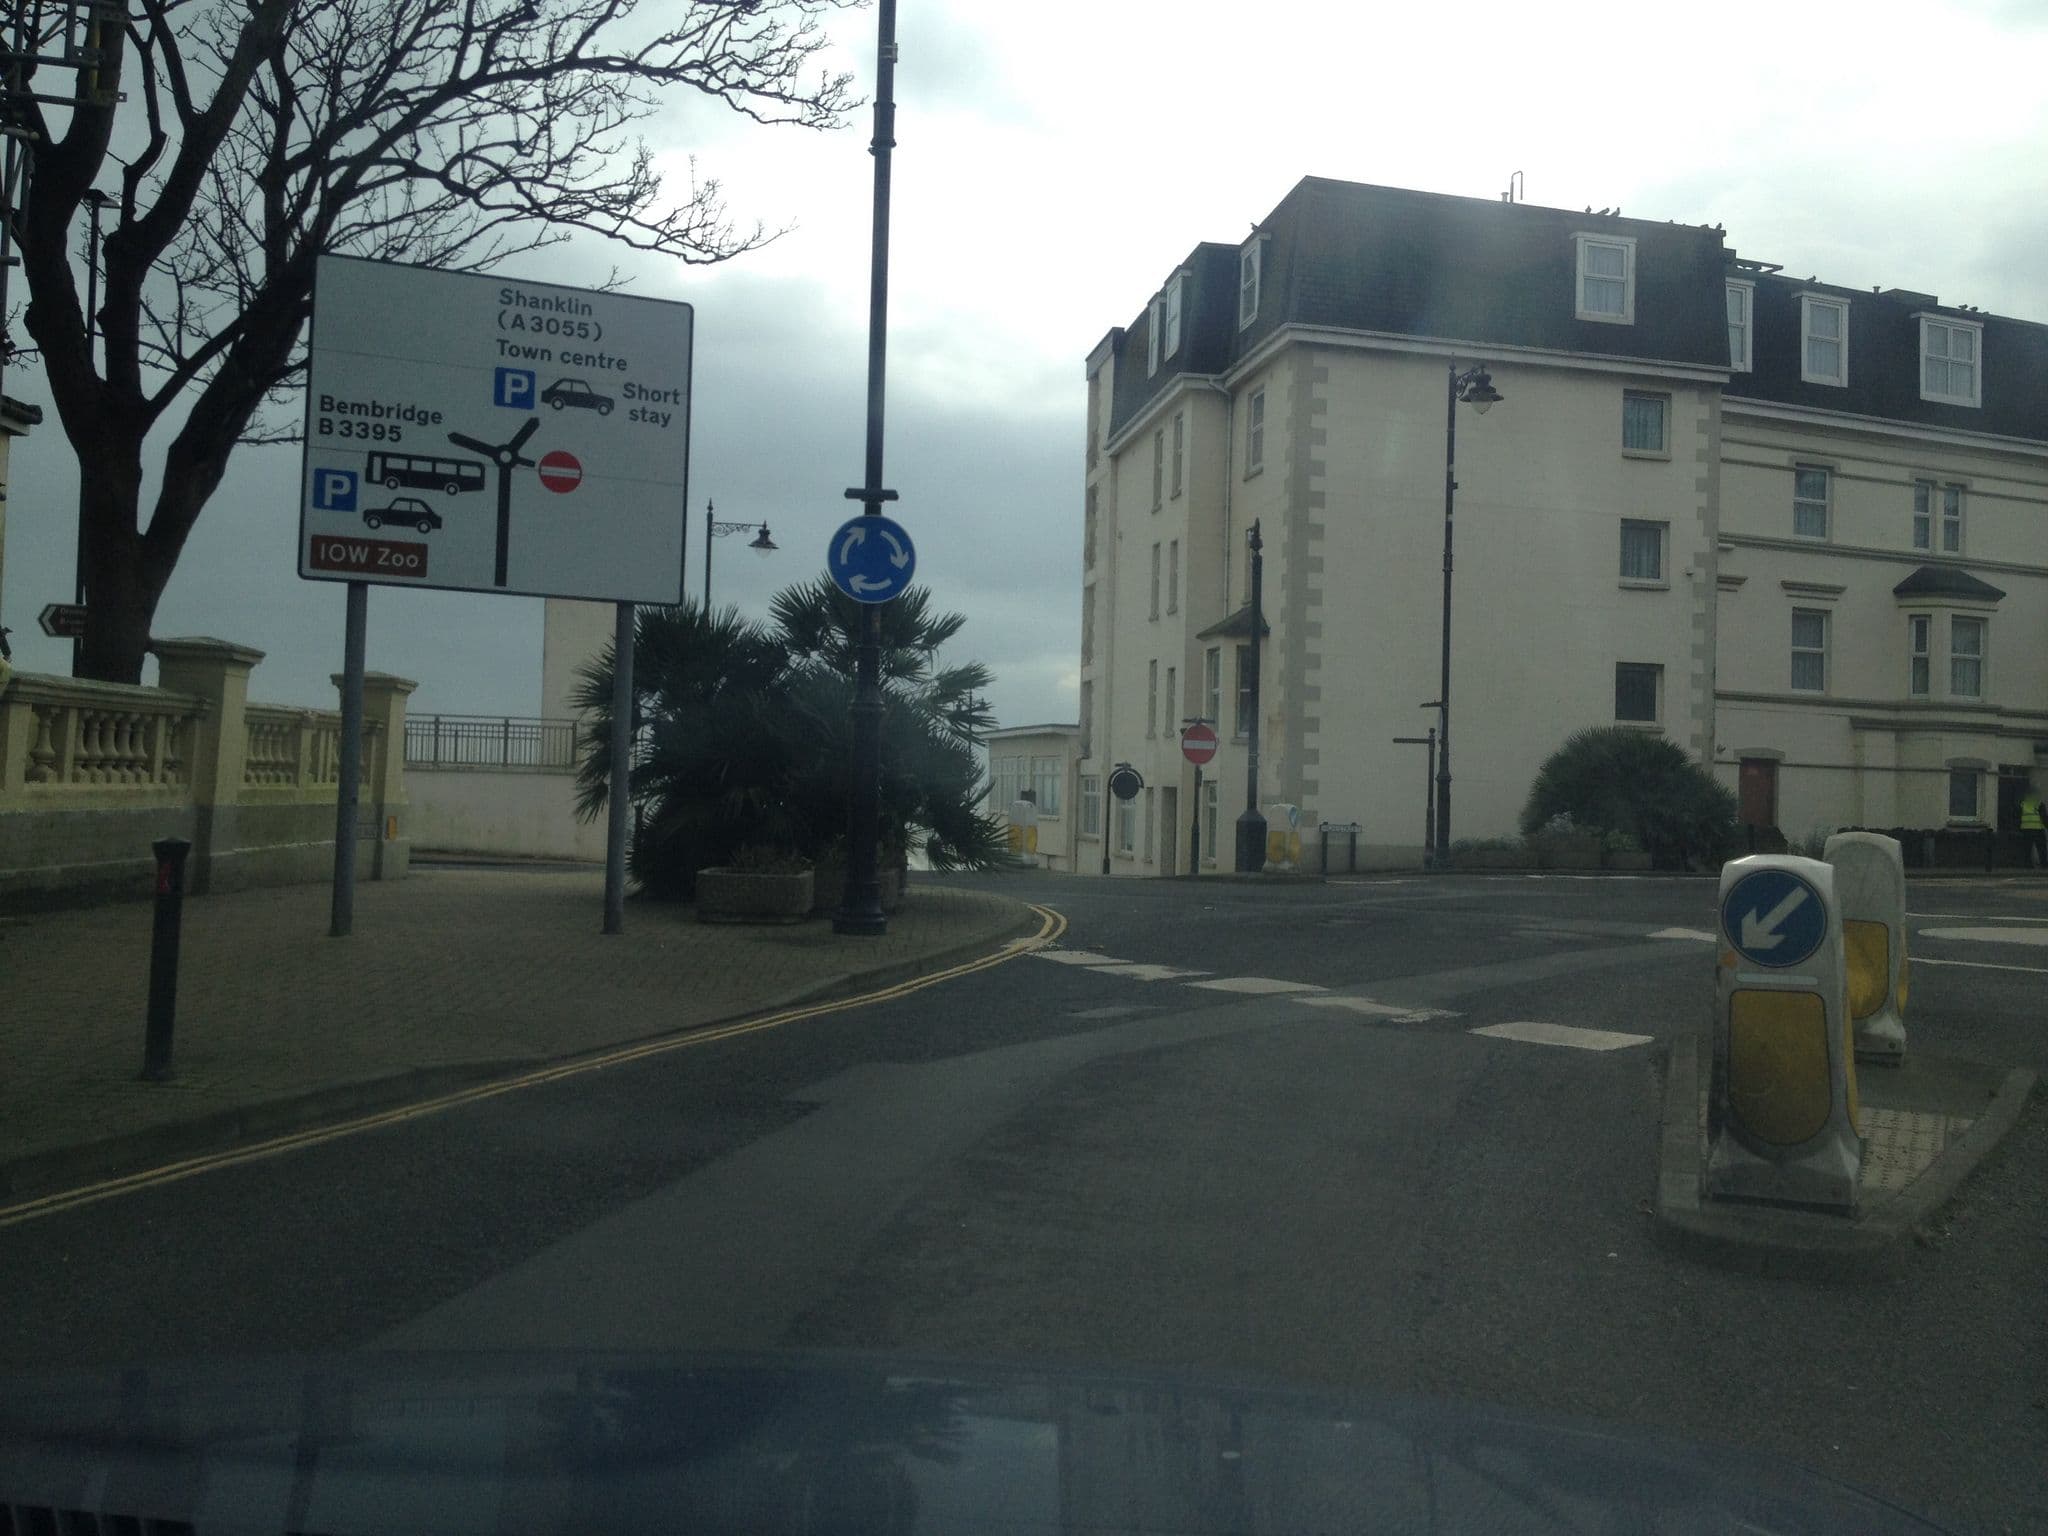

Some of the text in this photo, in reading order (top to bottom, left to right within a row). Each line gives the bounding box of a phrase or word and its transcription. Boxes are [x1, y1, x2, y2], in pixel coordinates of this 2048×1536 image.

[499, 288, 593, 316] Shanklin
[498, 310, 602, 342] (A3055)
[496, 338, 628, 371] Town centre
[504, 373, 530, 405] P
[623, 383, 680, 405] Short
[319, 395, 443, 426] Bembridge
[629, 407, 672, 428] stay
[323, 474, 350, 507] P
[320, 544, 419, 568] IOW Zoo
